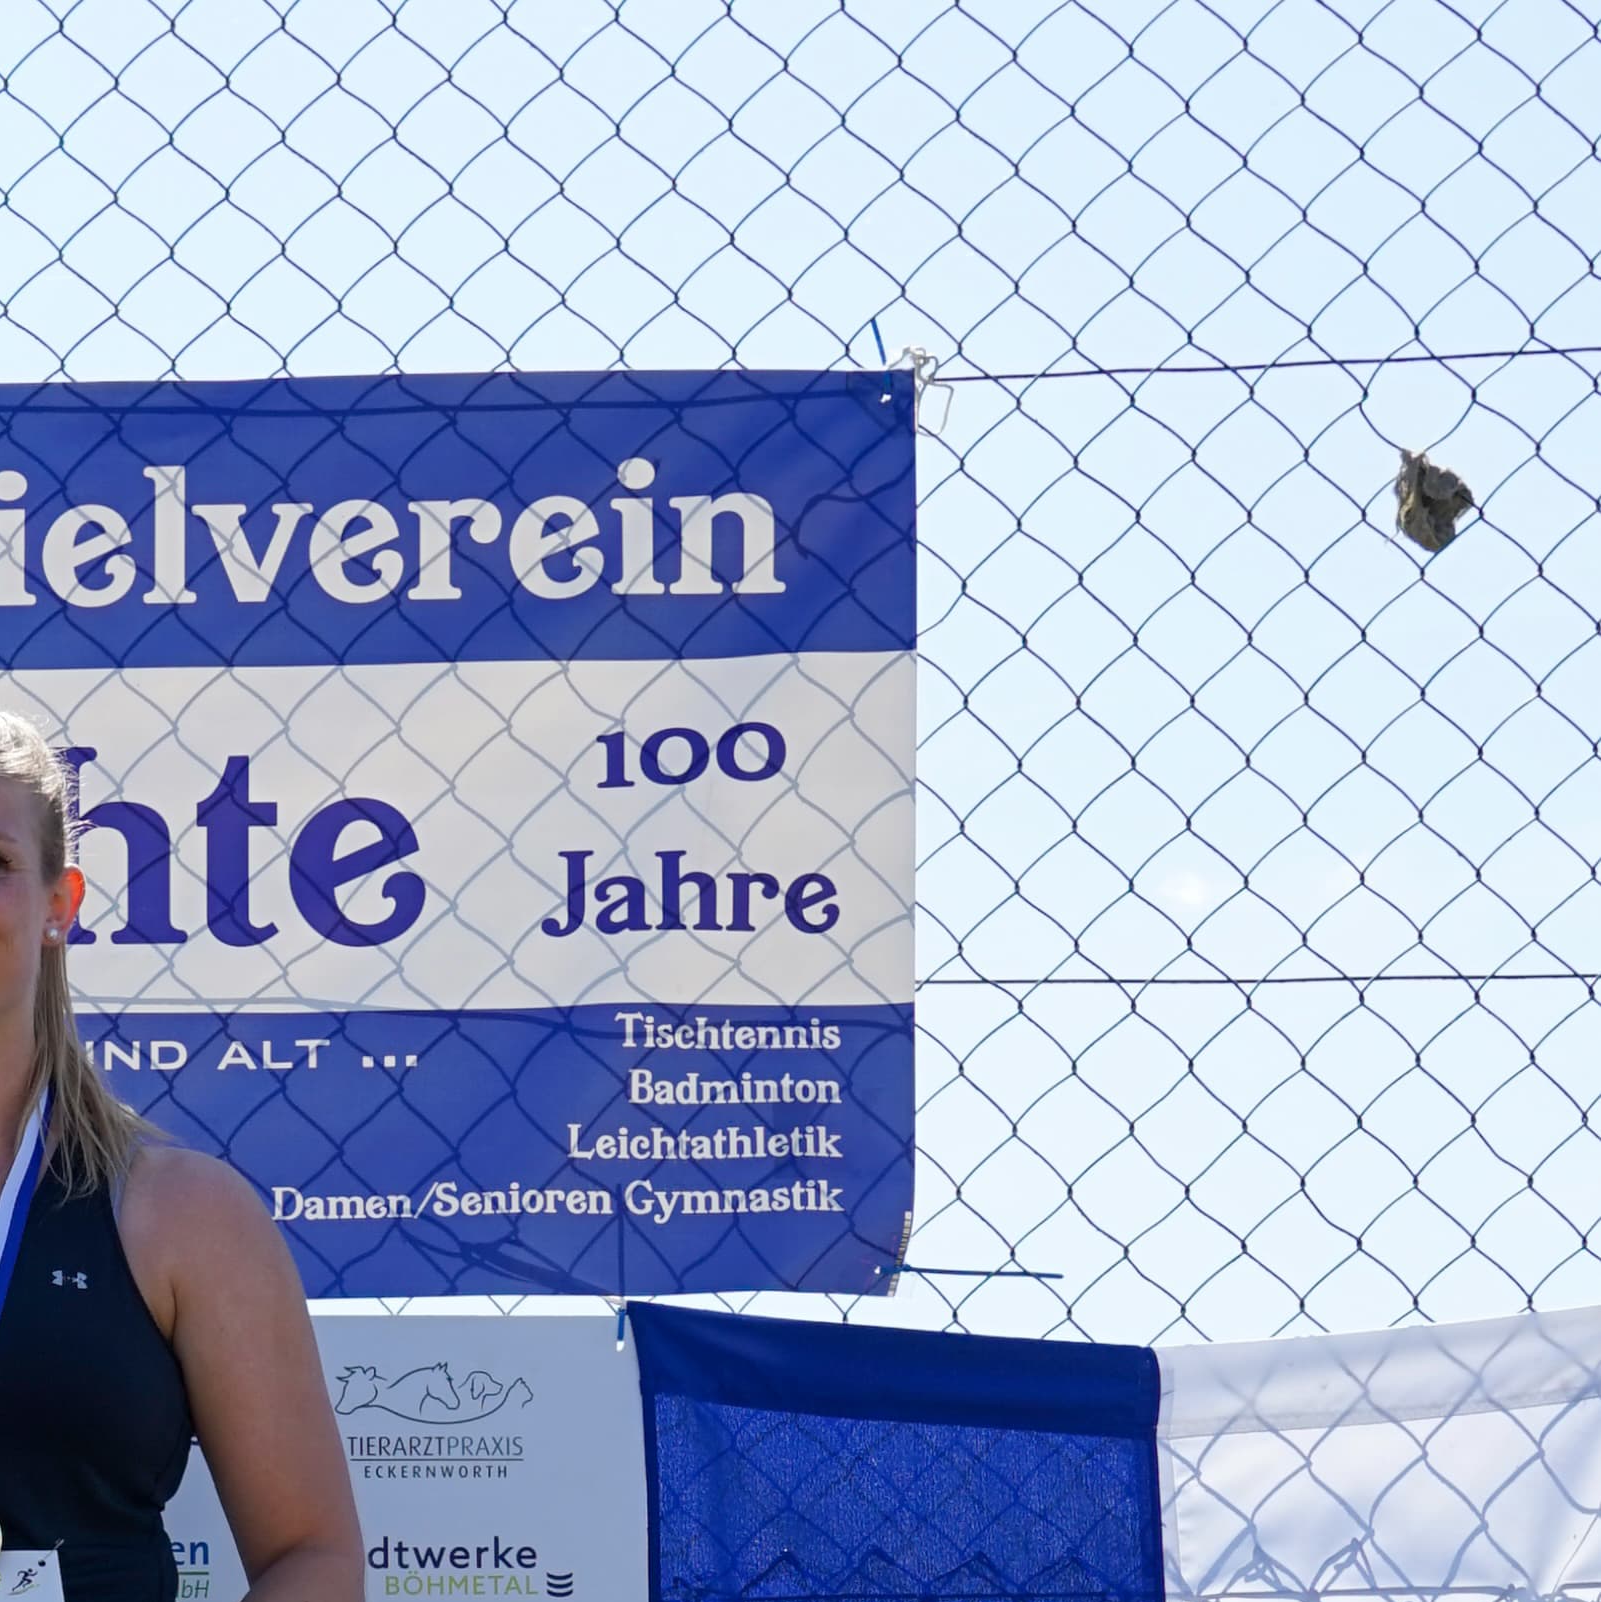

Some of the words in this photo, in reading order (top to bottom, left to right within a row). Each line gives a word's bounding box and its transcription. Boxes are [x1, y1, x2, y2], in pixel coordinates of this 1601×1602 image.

[596, 721, 788, 789] 100
[541, 850, 841, 939] Jahre
[615, 1012, 841, 1050] Tischtennis
[217, 1037, 331, 1070] ALT
[628, 1068, 841, 1105] Badminton
[568, 1123, 843, 1161] Leichtathletik
[272, 1180, 613, 1222] Damen/Senioren
[624, 1179, 844, 1224] Gymnastik
[347, 1436, 524, 1457] TIERARZTPRAXIS
[364, 1465, 508, 1479] ECKERNWORTH
[367, 1536, 537, 1569] dtwerke
[384, 1571, 539, 1595] BÖHMETAL
